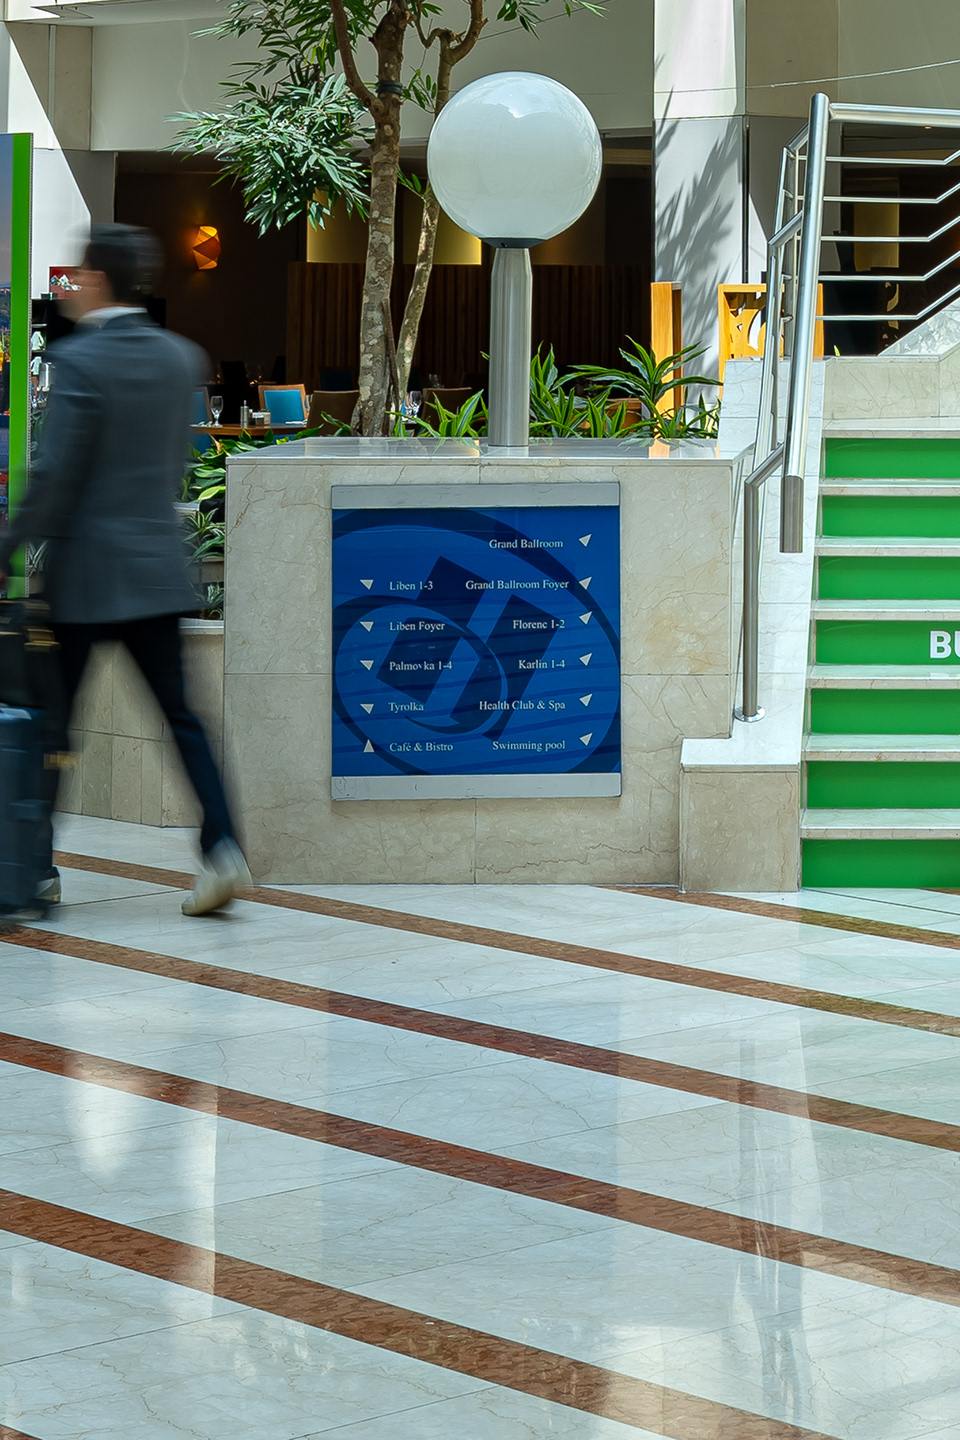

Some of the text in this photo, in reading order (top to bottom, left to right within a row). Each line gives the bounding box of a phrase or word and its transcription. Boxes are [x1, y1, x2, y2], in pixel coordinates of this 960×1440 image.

[489, 539, 564, 549] Grand Ballroom
[389, 581, 434, 591] Liben 1-3
[465, 579, 570, 591] Grand Ballroom Foyer
[389, 621, 446, 632] Liben Foyer
[512, 619, 566, 629] Florenc 1-2
[438, 661, 453, 670] 1-4
[518, 659, 566, 669] Karlin 1-4
[388, 701, 424, 713] Tyrolka
[479, 700, 566, 711] Health Club & Spa
[389, 742, 454, 752] Café & Bistro
[492, 740, 566, 752] Swimming pool
